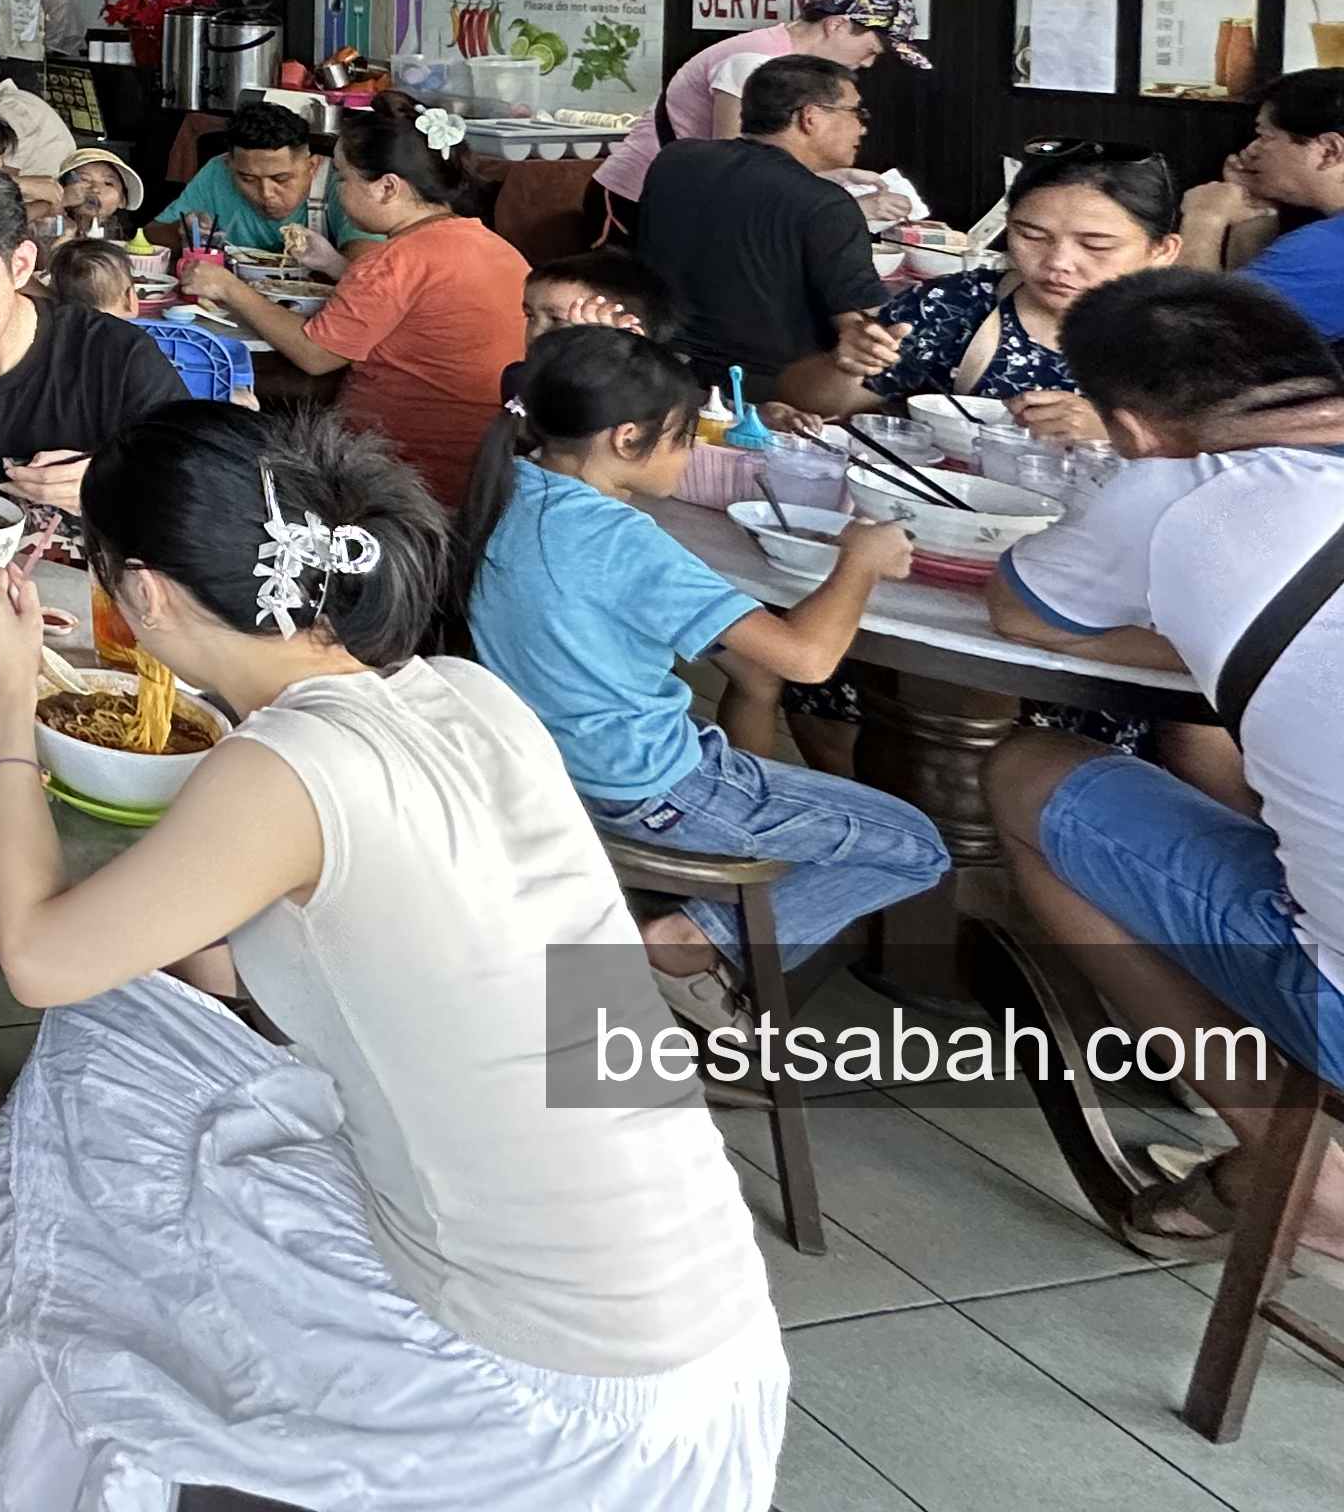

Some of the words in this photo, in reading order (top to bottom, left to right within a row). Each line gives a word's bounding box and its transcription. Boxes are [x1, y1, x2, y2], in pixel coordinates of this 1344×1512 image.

[523, 0, 553, 11] Please
[555, 1, 568, 11] do
[570, 2, 588, 12] not
[590, 3, 620, 13] waste
